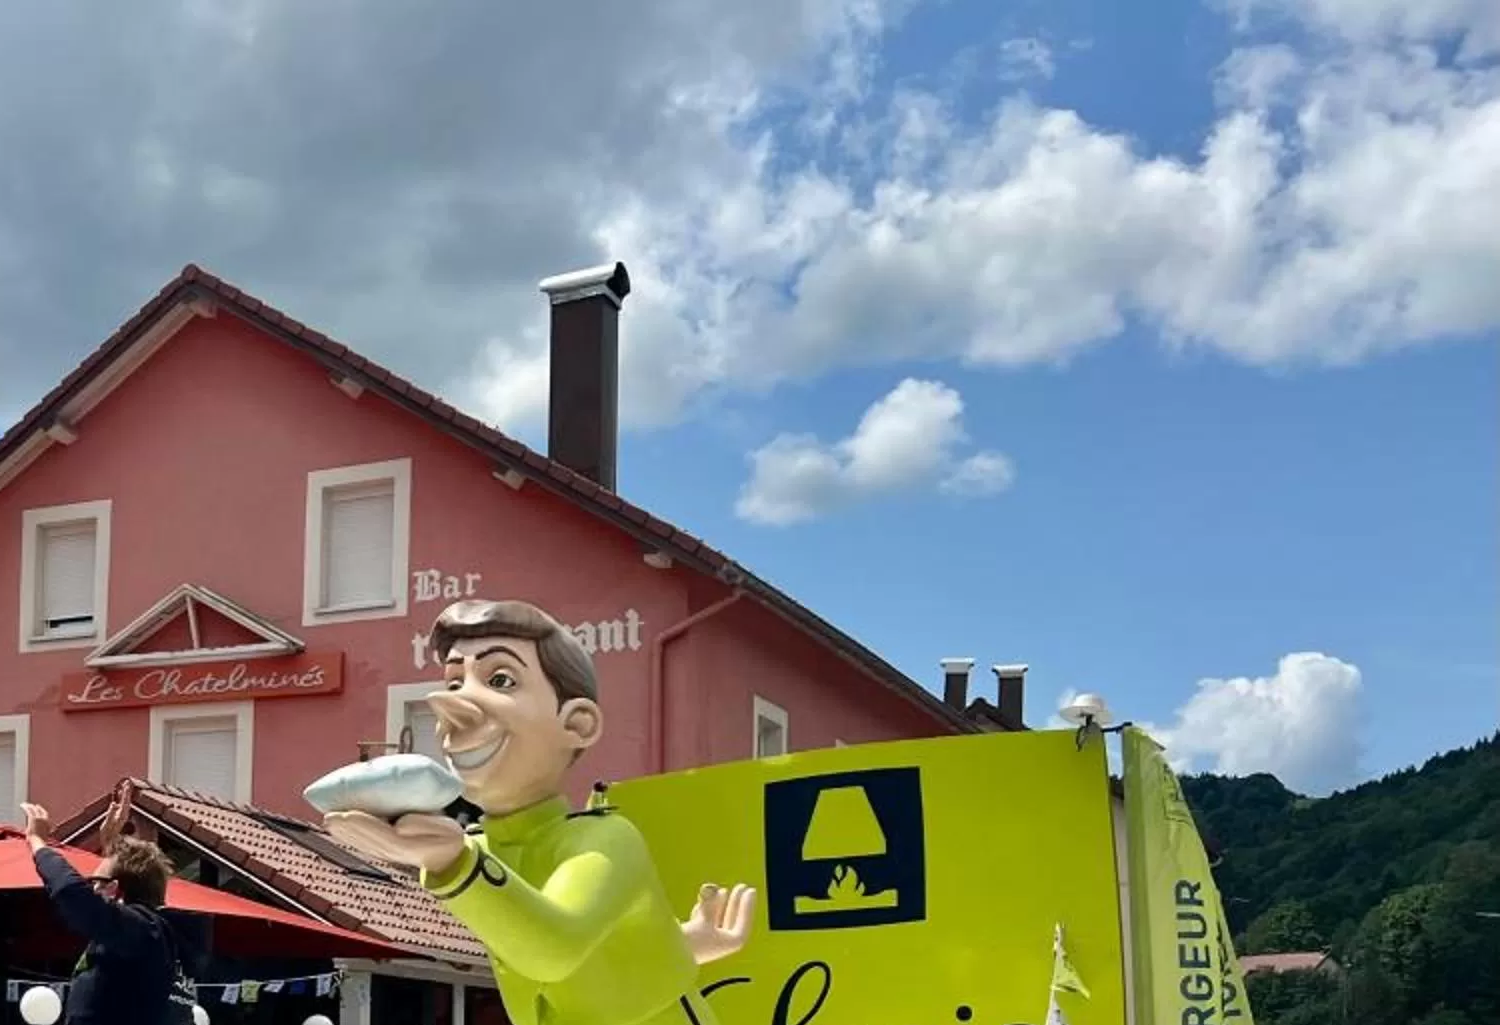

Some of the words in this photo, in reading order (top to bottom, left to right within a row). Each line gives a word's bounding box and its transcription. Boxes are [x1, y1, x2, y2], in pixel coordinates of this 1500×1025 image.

[412, 568, 481, 601] Bar
[67, 674, 123, 702] Les
[134, 664, 325, 700] Chatelminés
